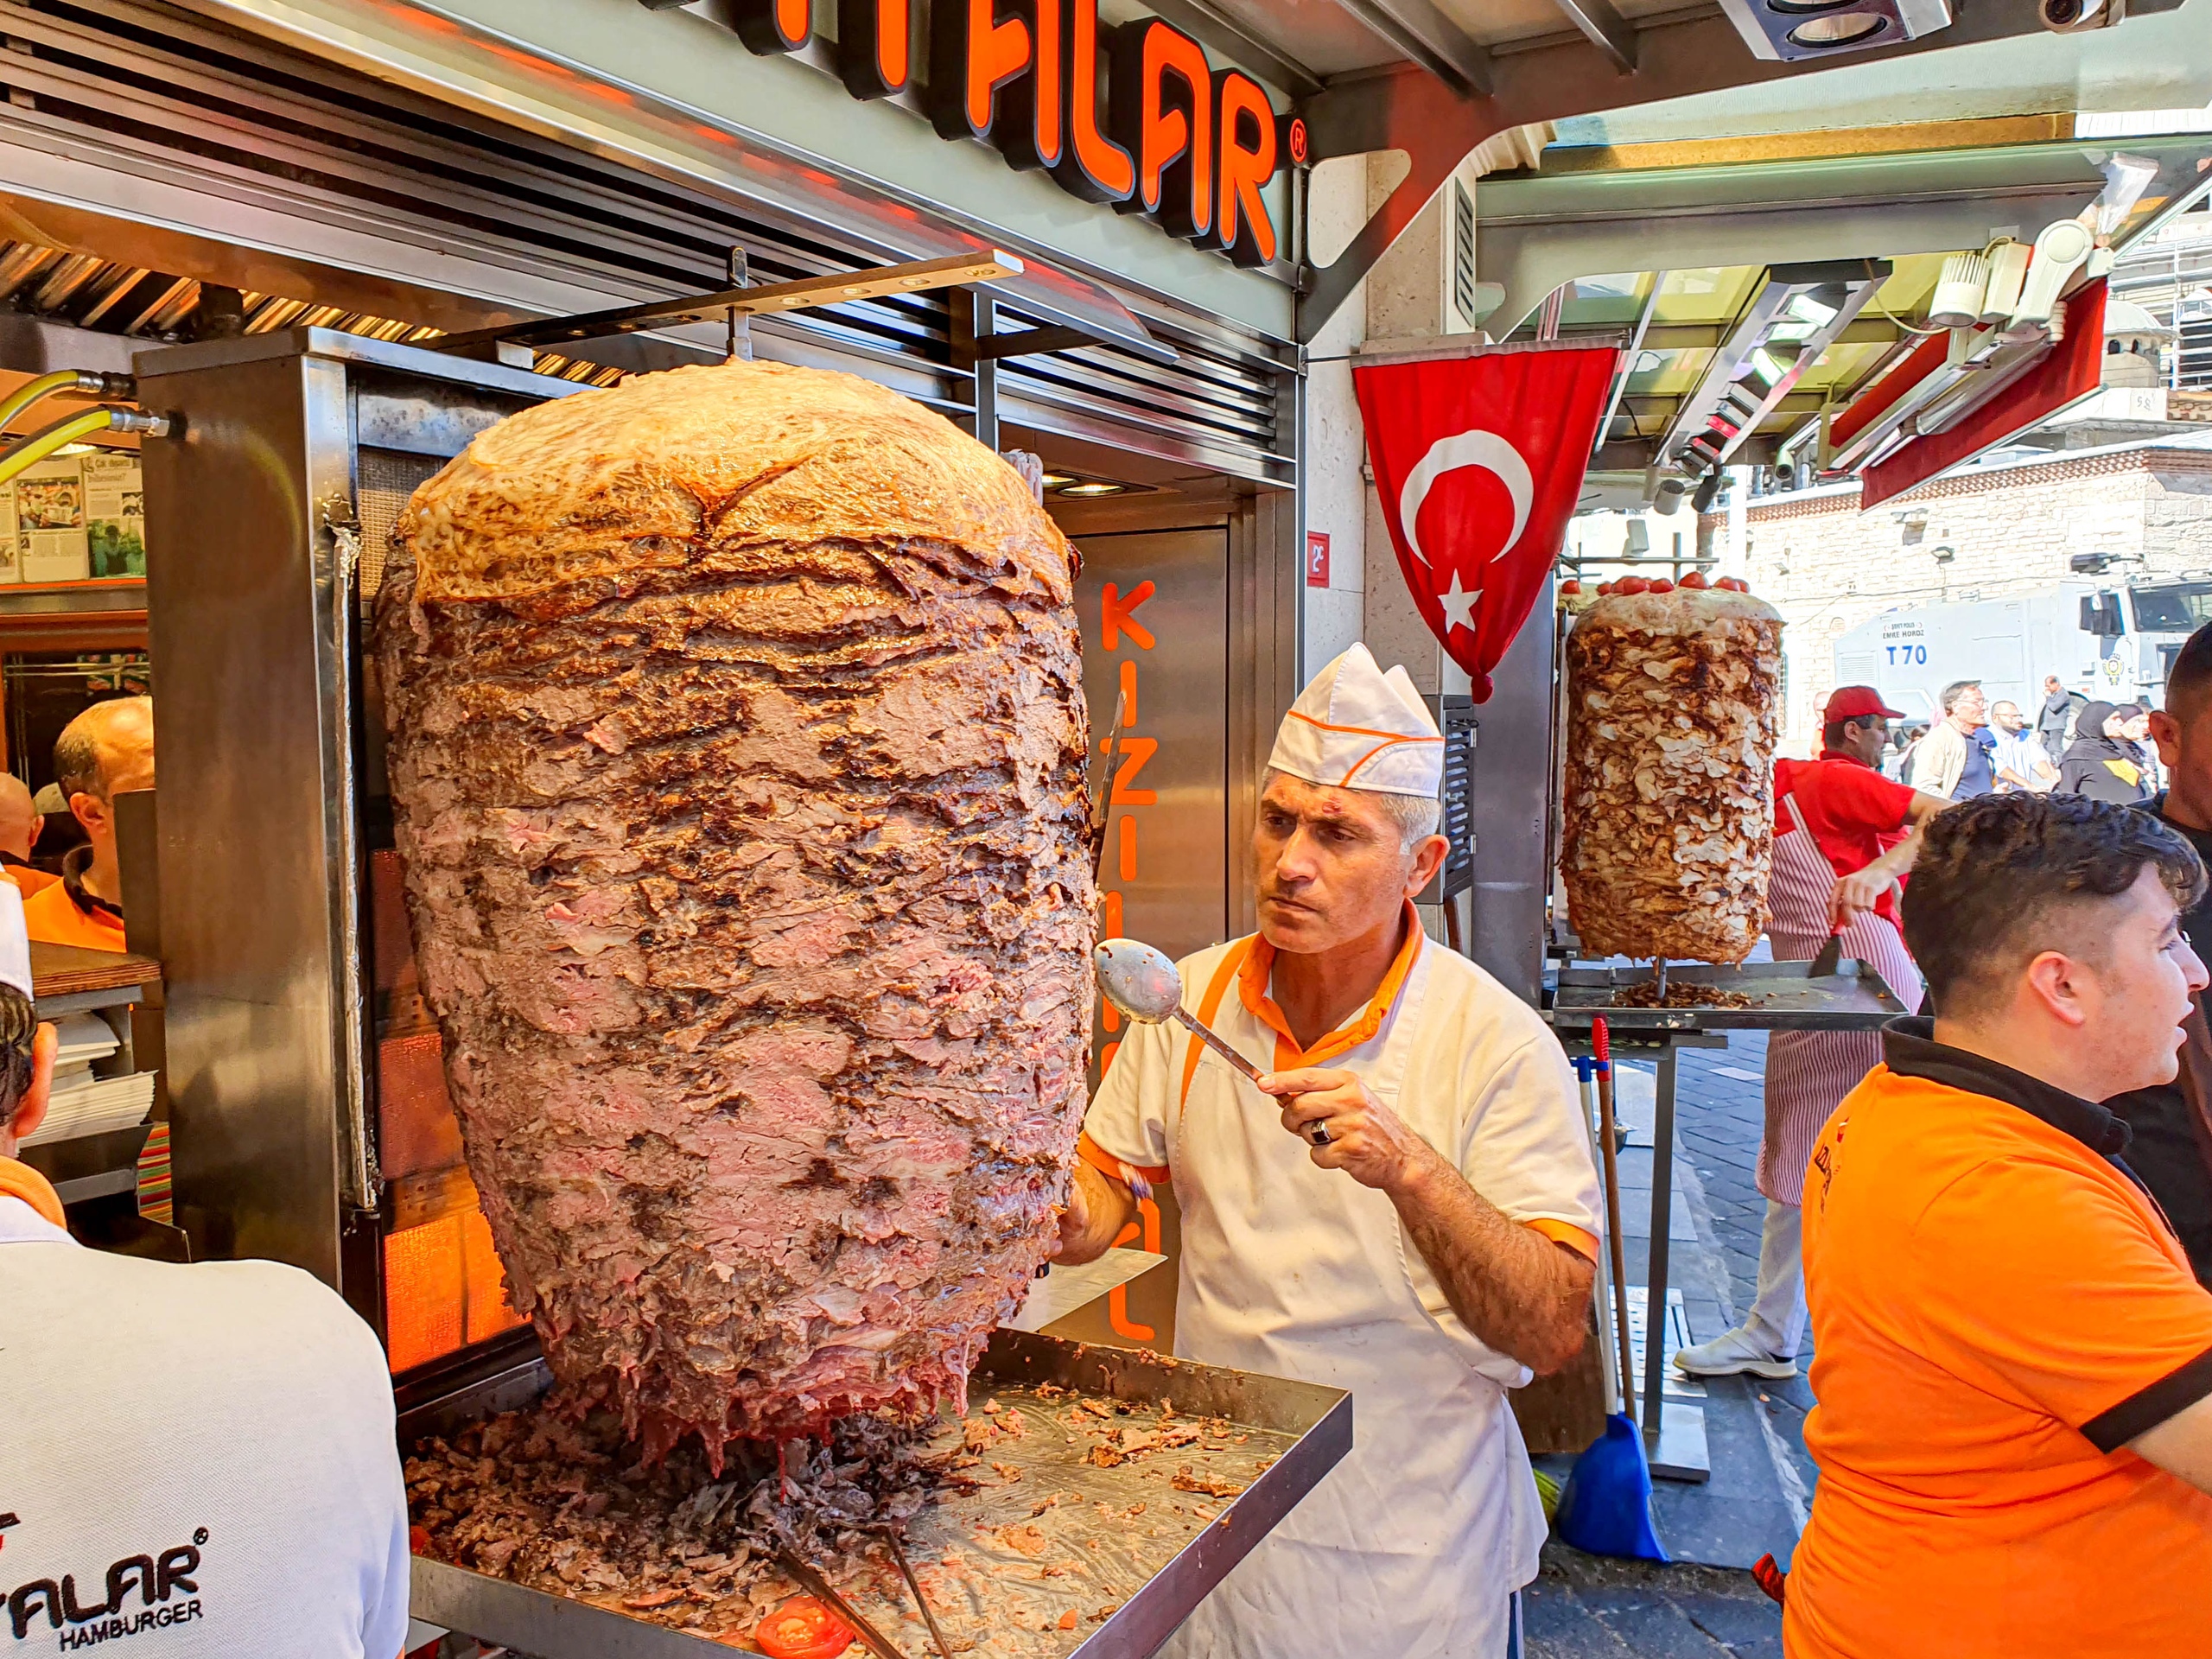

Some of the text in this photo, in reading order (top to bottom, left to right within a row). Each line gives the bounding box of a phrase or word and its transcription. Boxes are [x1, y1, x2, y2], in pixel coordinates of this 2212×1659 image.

[1902, 645, 1927, 664] 70
[0, 1544, 200, 1639] ALAR
[60, 1599, 203, 1652] HAMBURGER
